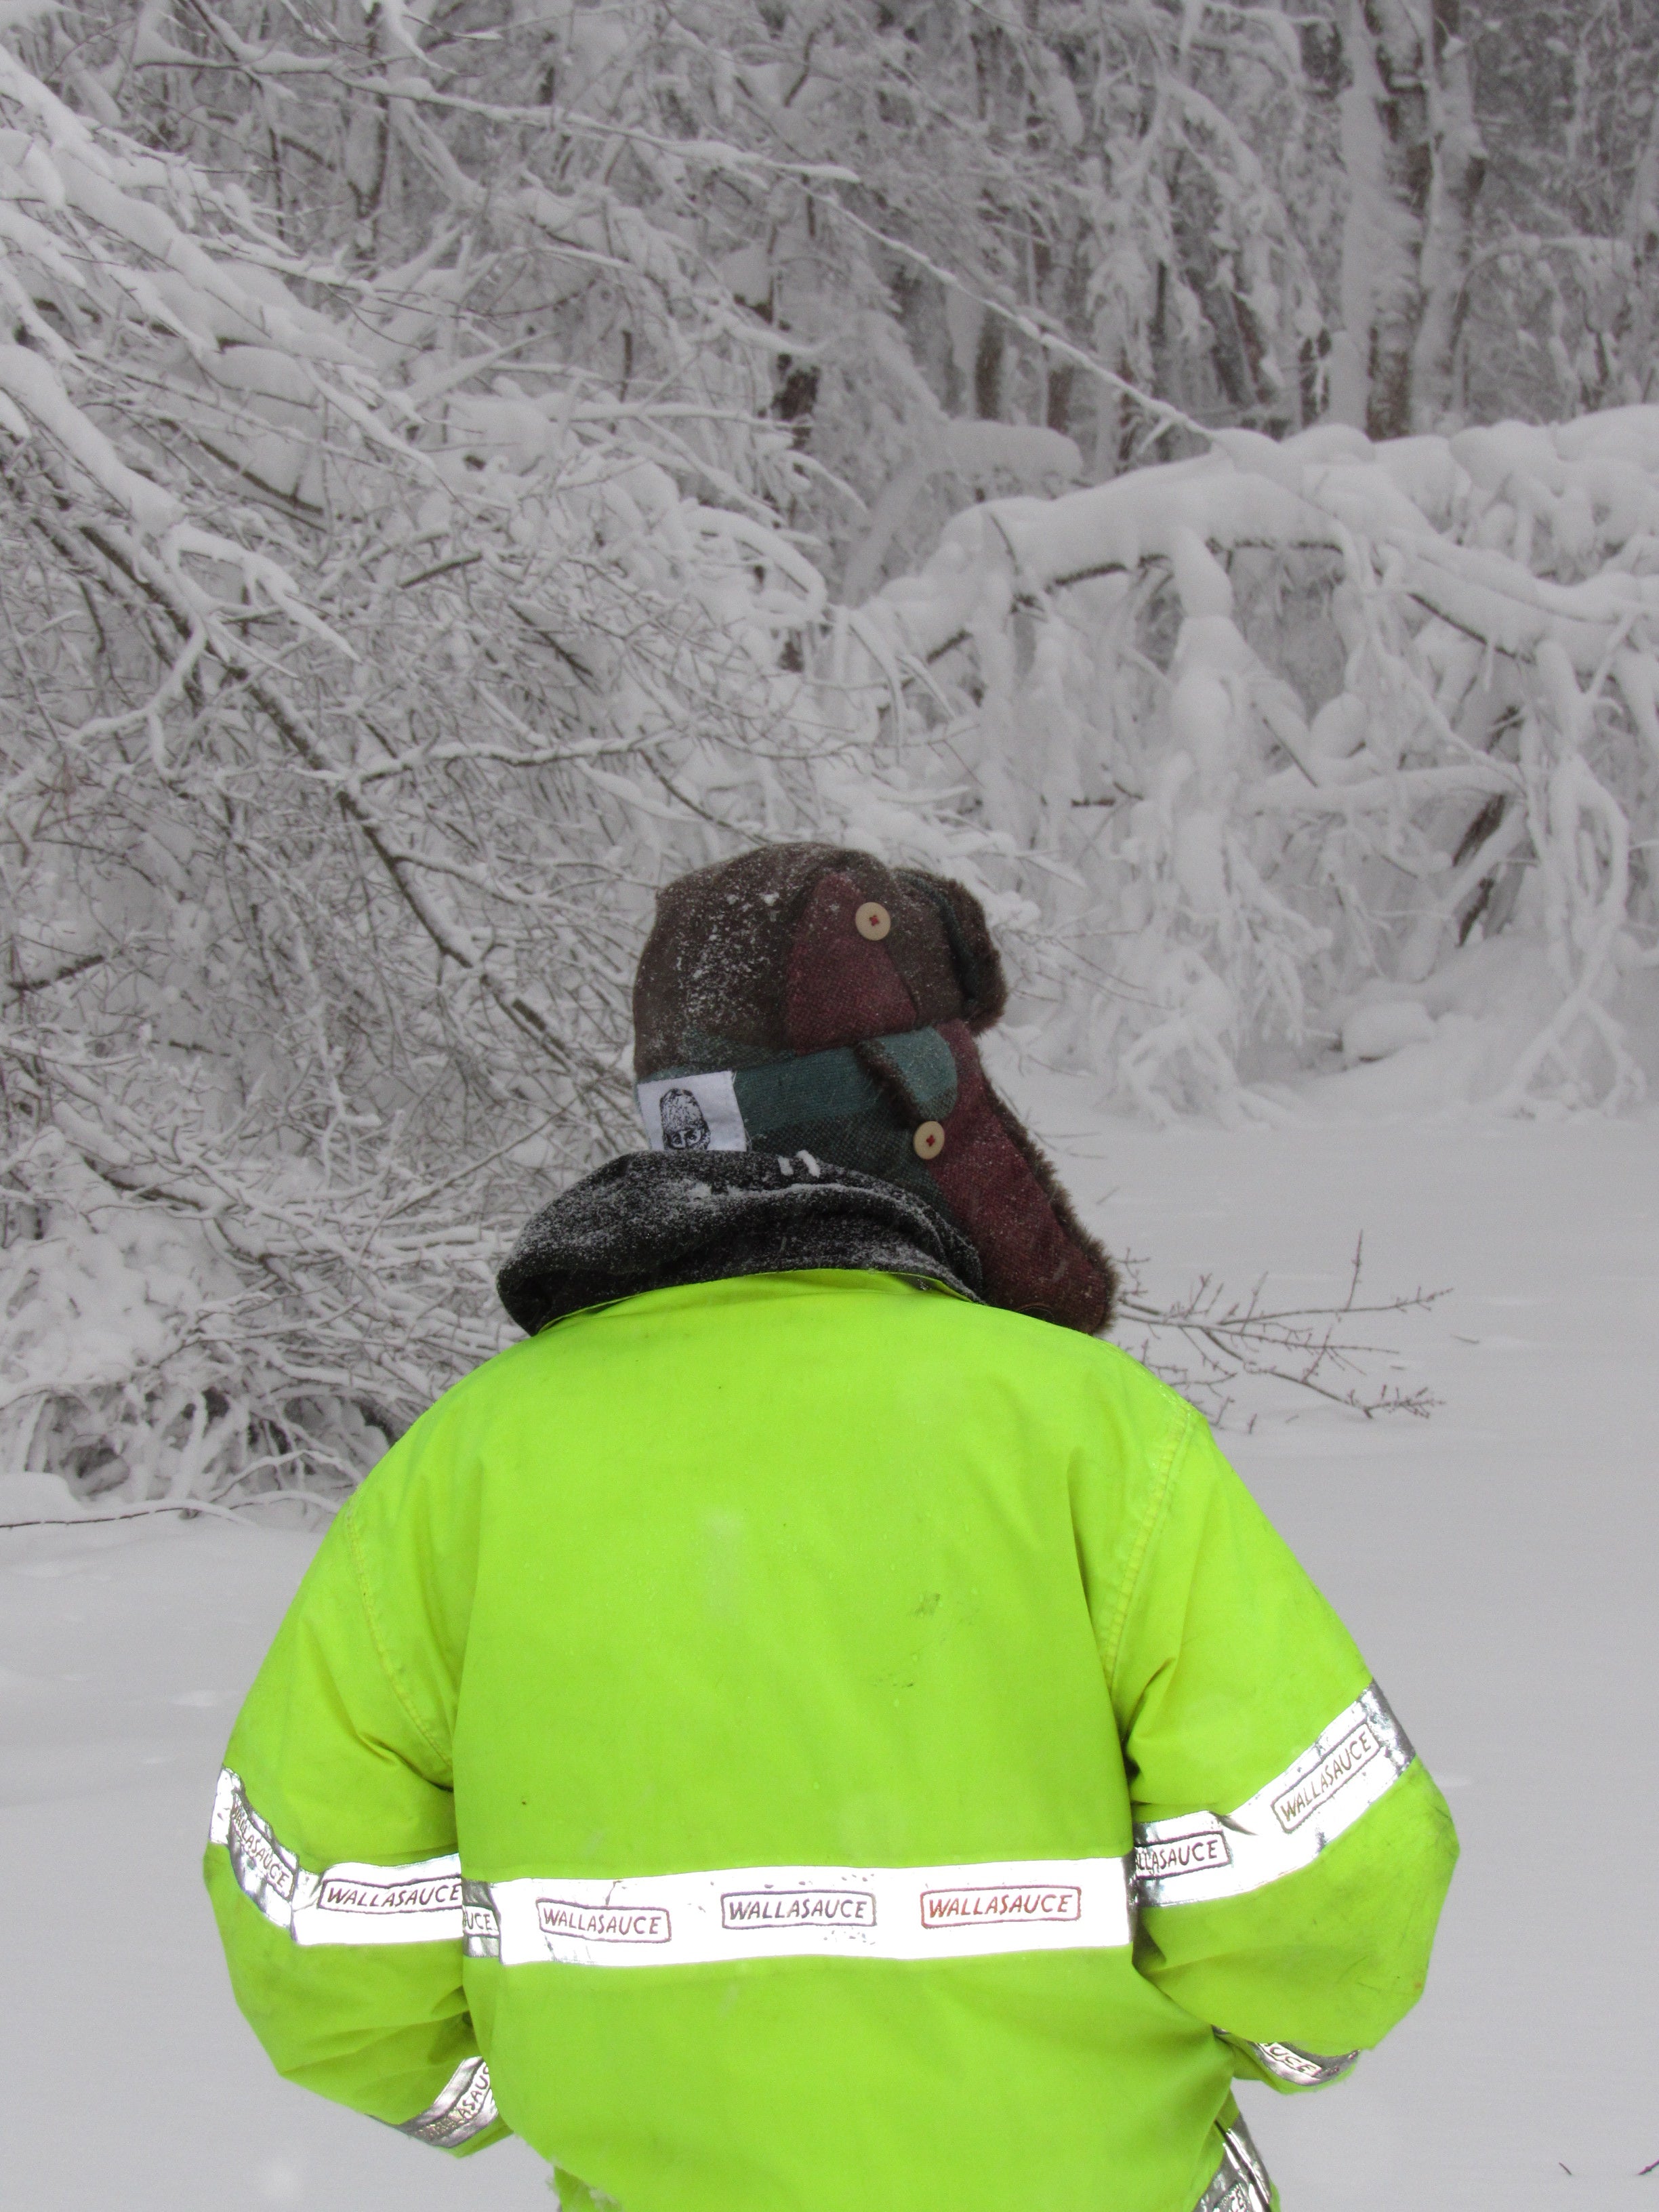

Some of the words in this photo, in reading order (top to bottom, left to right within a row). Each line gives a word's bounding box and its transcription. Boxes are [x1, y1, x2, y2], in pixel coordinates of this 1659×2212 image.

[1280, 1731, 1372, 1822] WALLASAUCE
[327, 1883, 462, 1907] WALLASAUCE
[929, 1893, 1072, 1917] WALLASAUCE
[729, 1898, 868, 1921] WALLASAUCE
[543, 1908, 661, 1936] WALLASAUCE
